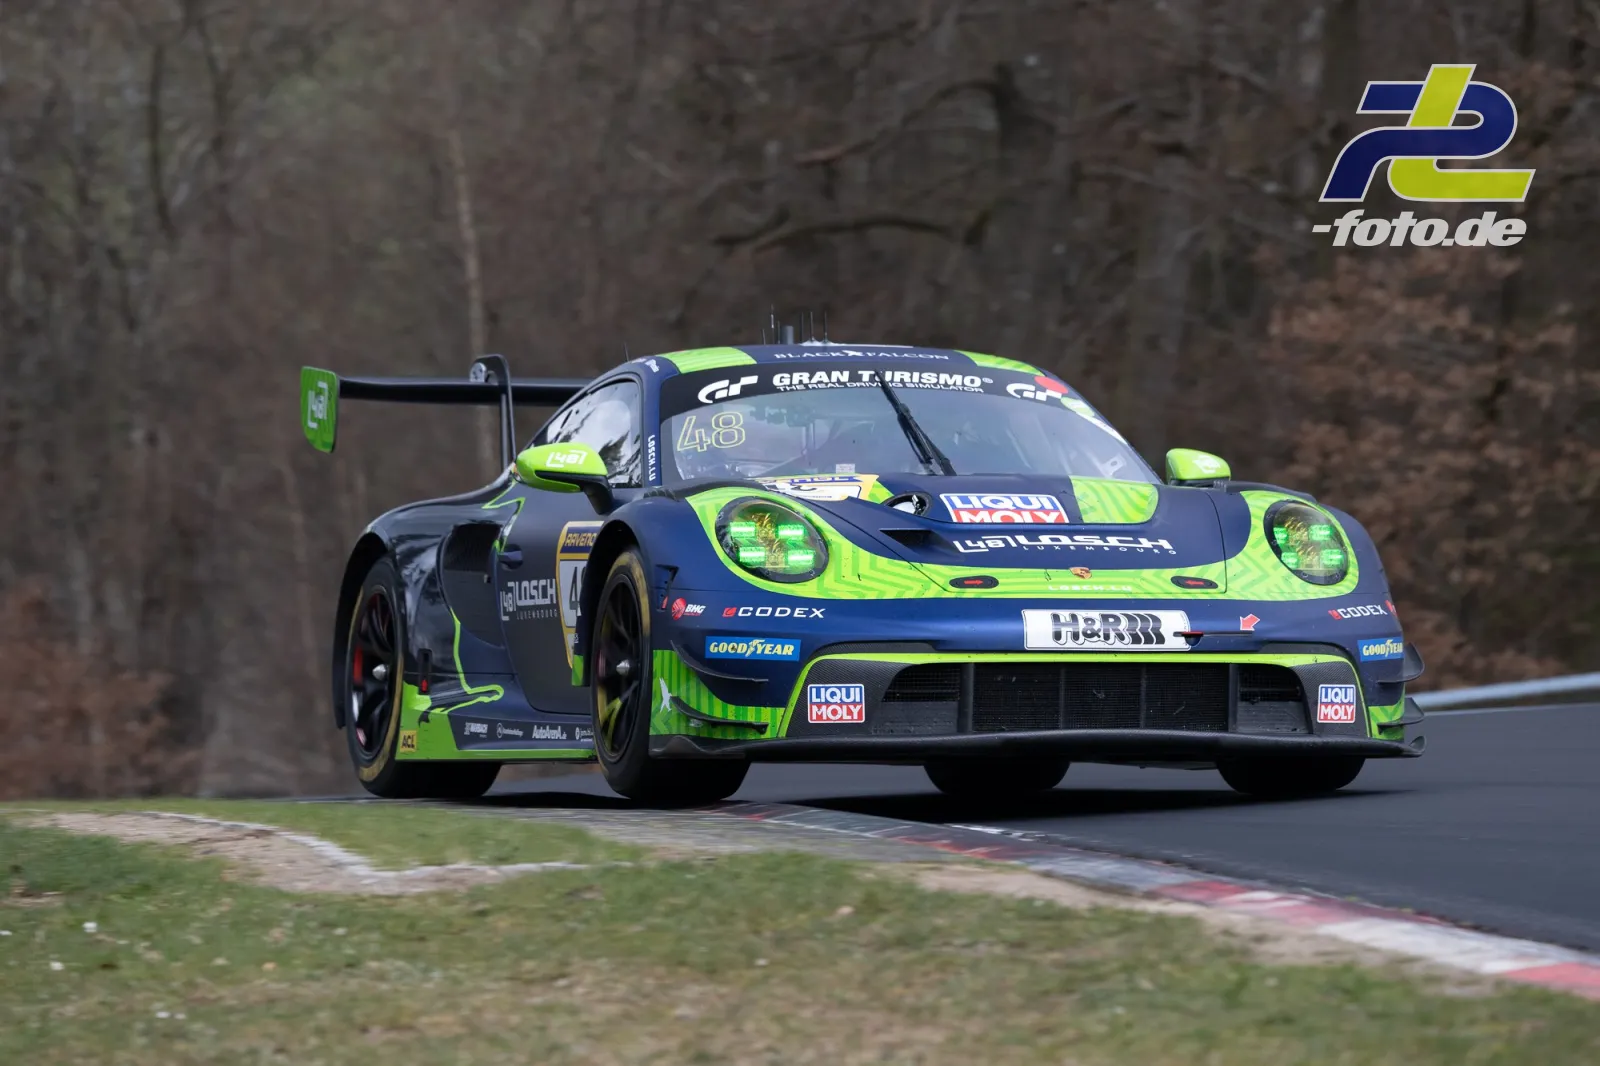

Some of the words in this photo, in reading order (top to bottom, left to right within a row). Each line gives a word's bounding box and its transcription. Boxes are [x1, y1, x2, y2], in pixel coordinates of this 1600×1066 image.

[866, 352, 949, 360] FALCON
[772, 370, 850, 386] GRAN
[776, 384, 806, 392] THE
[905, 383, 985, 393] SIMULATOR
[676, 411, 746, 454] 48
[949, 495, 1055, 511] LIQUI
[564, 532, 598, 547] RAVENO
[1014, 535, 1174, 550] LOSCH
[1022, 546, 1177, 555] LUXEMBOURG
[515, 578, 557, 607] LOSCH
[569, 566, 587, 617] 4
[737, 606, 826, 619] CODEX
[1337, 604, 1388, 619] CODEX
[709, 639, 795, 657] GOODYEAR
[811, 687, 861, 704] LIQUI
[1321, 687, 1354, 704] LIQUI
[811, 704, 864, 721] MOLY
[1319, 704, 1355, 721] MOLY
